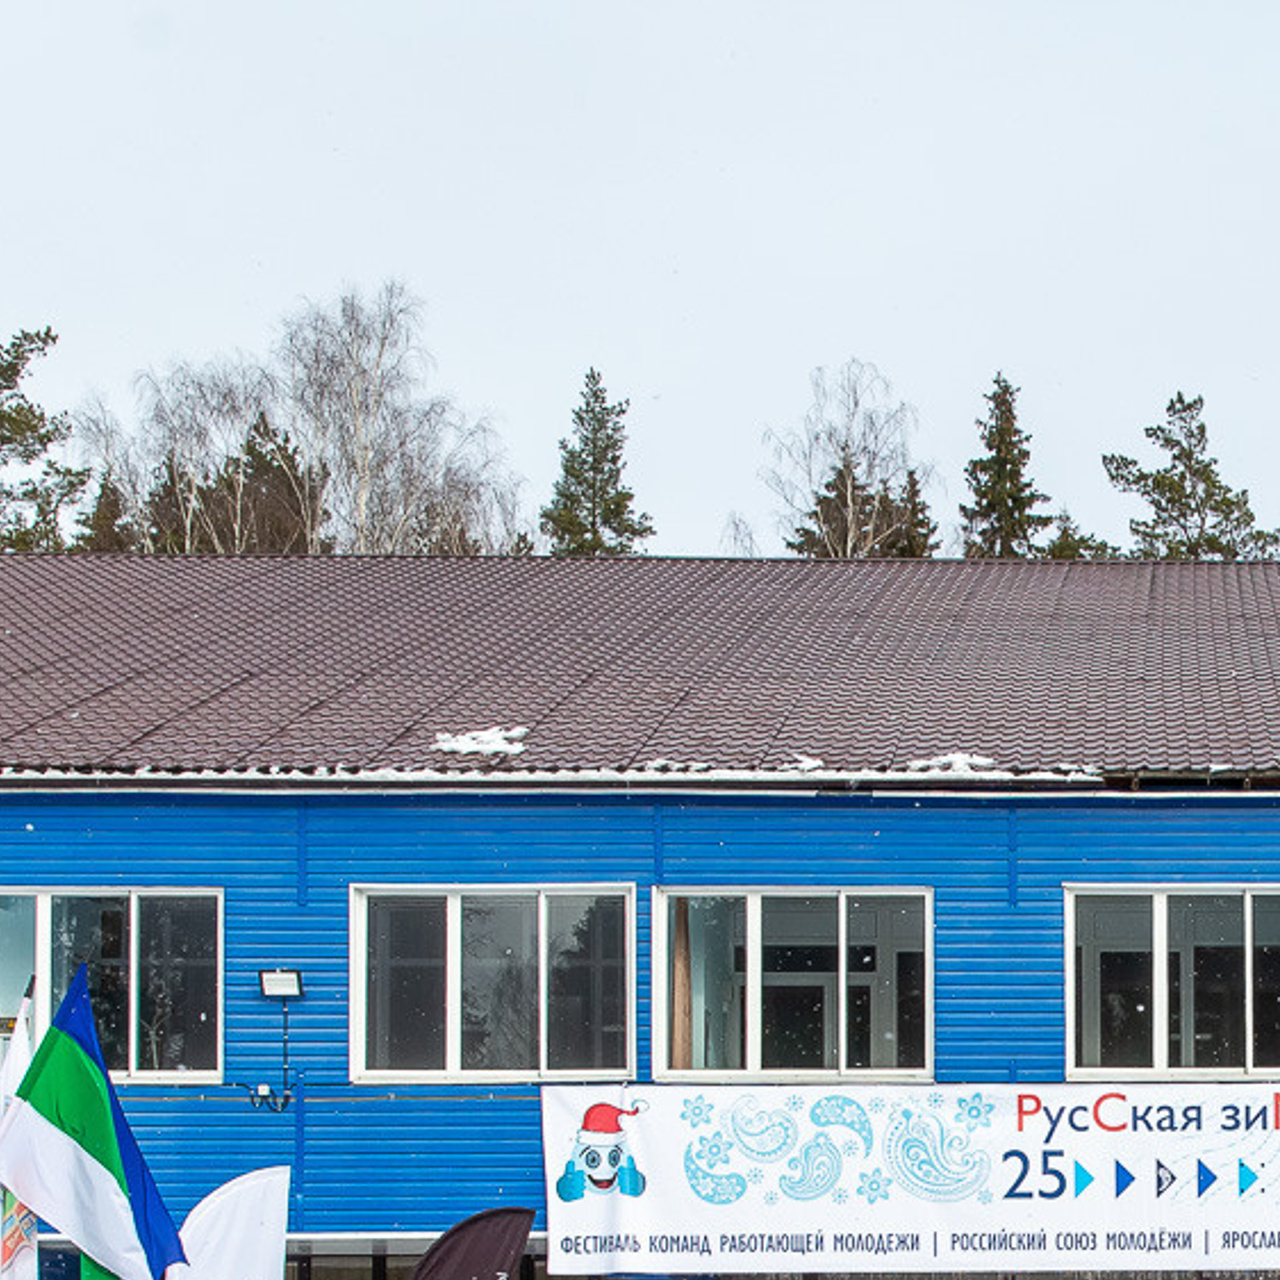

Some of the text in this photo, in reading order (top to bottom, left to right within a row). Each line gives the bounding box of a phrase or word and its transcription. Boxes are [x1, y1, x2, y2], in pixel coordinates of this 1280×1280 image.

[1016, 1092, 1203, 1143] РусСкая
[1002, 1149, 1067, 1200] 25
[560, 1233, 641, 1255] ФЕСТИВАЛЬ
[649, 1233, 712, 1256] КОМАНД
[720, 1229, 824, 1256] РАБОТАЮЩЕЙ
[951, 1227, 1047, 1252] РОССИЙСКИЙ
[1055, 1230, 1097, 1251] СОЮЗ
